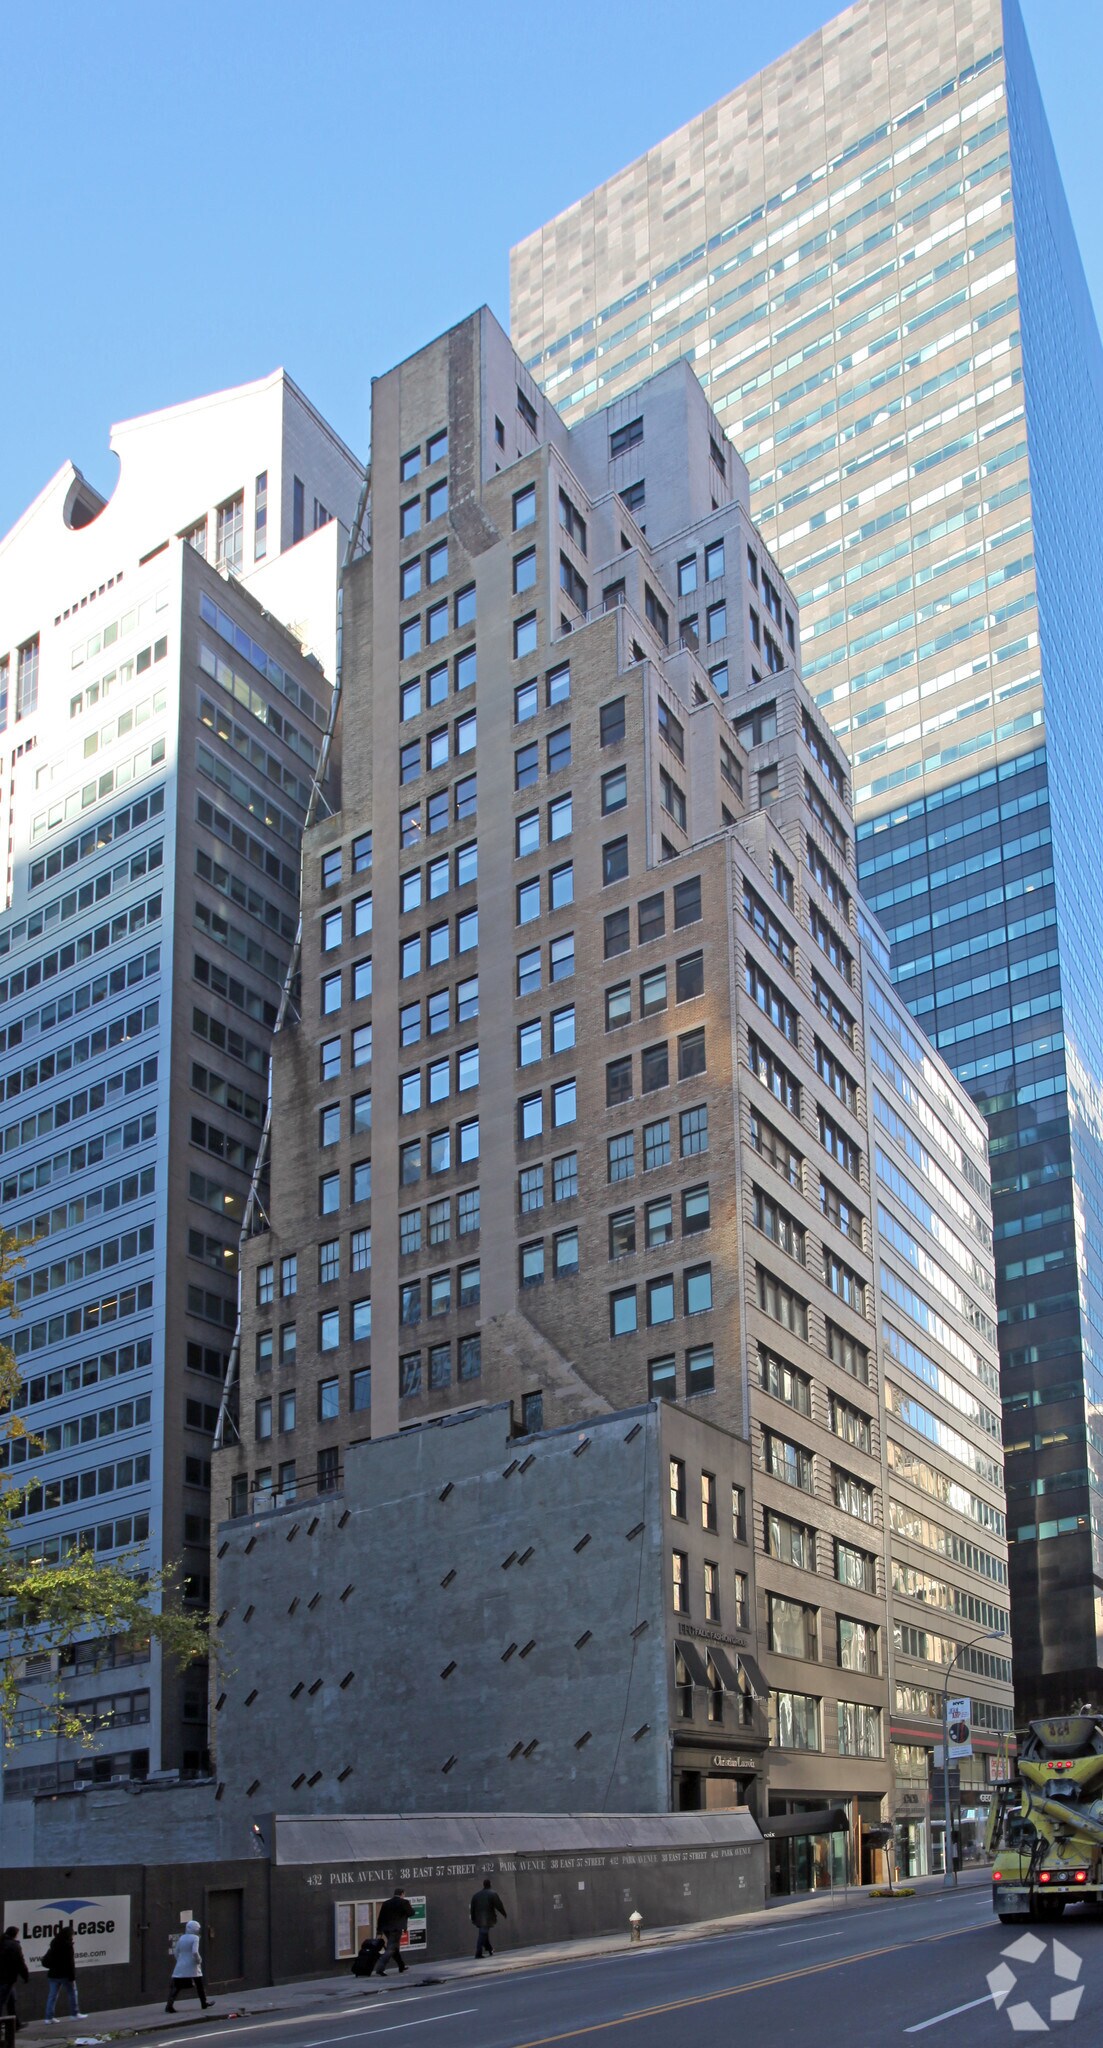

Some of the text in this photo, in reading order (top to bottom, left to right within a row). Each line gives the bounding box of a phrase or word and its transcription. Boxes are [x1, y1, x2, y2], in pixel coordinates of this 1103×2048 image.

[307, 1874, 322, 1886] 432
[330, 1872, 354, 1885] PARK
[357, 1869, 394, 1882] AVENUE
[400, 1868, 410, 1879] 38
[413, 1867, 433, 1878] EAST
[436, 1866, 445, 1877] 57
[447, 1864, 476, 1875] STREET
[481, 1863, 494, 1872] 432
[500, 1862, 517, 1872] PARK
[520, 1860, 546, 1871] AVENUE
[551, 1860, 558, 1868] 38
[560, 1859, 575, 1868] EAST
[577, 1858, 583, 1867] 57
[585, 1857, 605, 1867] STREET
[622, 1855, 636, 1864] PARK
[638, 1854, 658, 1864] AVENUE
[661, 1854, 668, 1862] 38
[668, 1853, 681, 1862] EAST
[689, 1851, 707, 1860] STREET
[721, 1849, 733, 1857] PARK
[734, 1847, 752, 1856] AVENUE
[23, 1919, 115, 1940] Lend Lease
